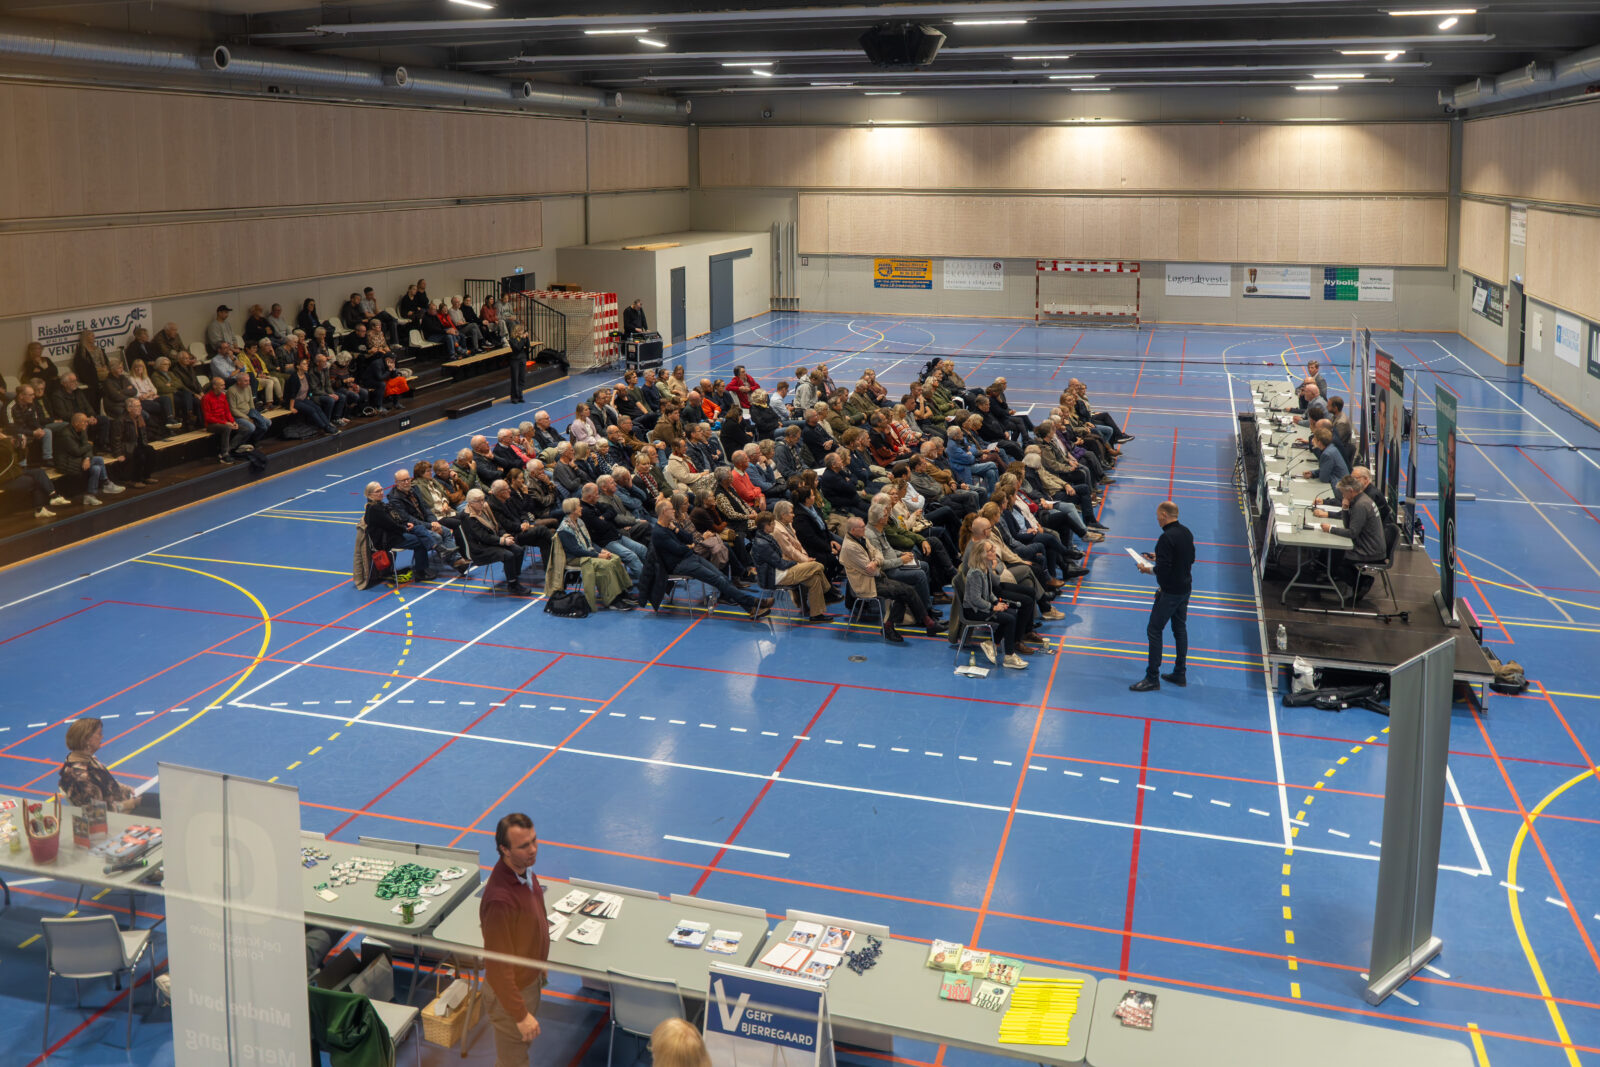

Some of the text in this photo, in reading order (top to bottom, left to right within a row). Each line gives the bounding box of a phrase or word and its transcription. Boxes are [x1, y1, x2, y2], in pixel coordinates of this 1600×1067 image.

[1324, 279, 1359, 288] Nybolig
[38, 324, 74, 337] Risskov
[76, 320, 88, 331] EL
[90, 319, 98, 329] &
[98, 315, 120, 327] VVS
[713, 978, 751, 1032] V
[745, 1009, 774, 1023] GERT
[741, 1022, 814, 1046] BJERREGAARD
